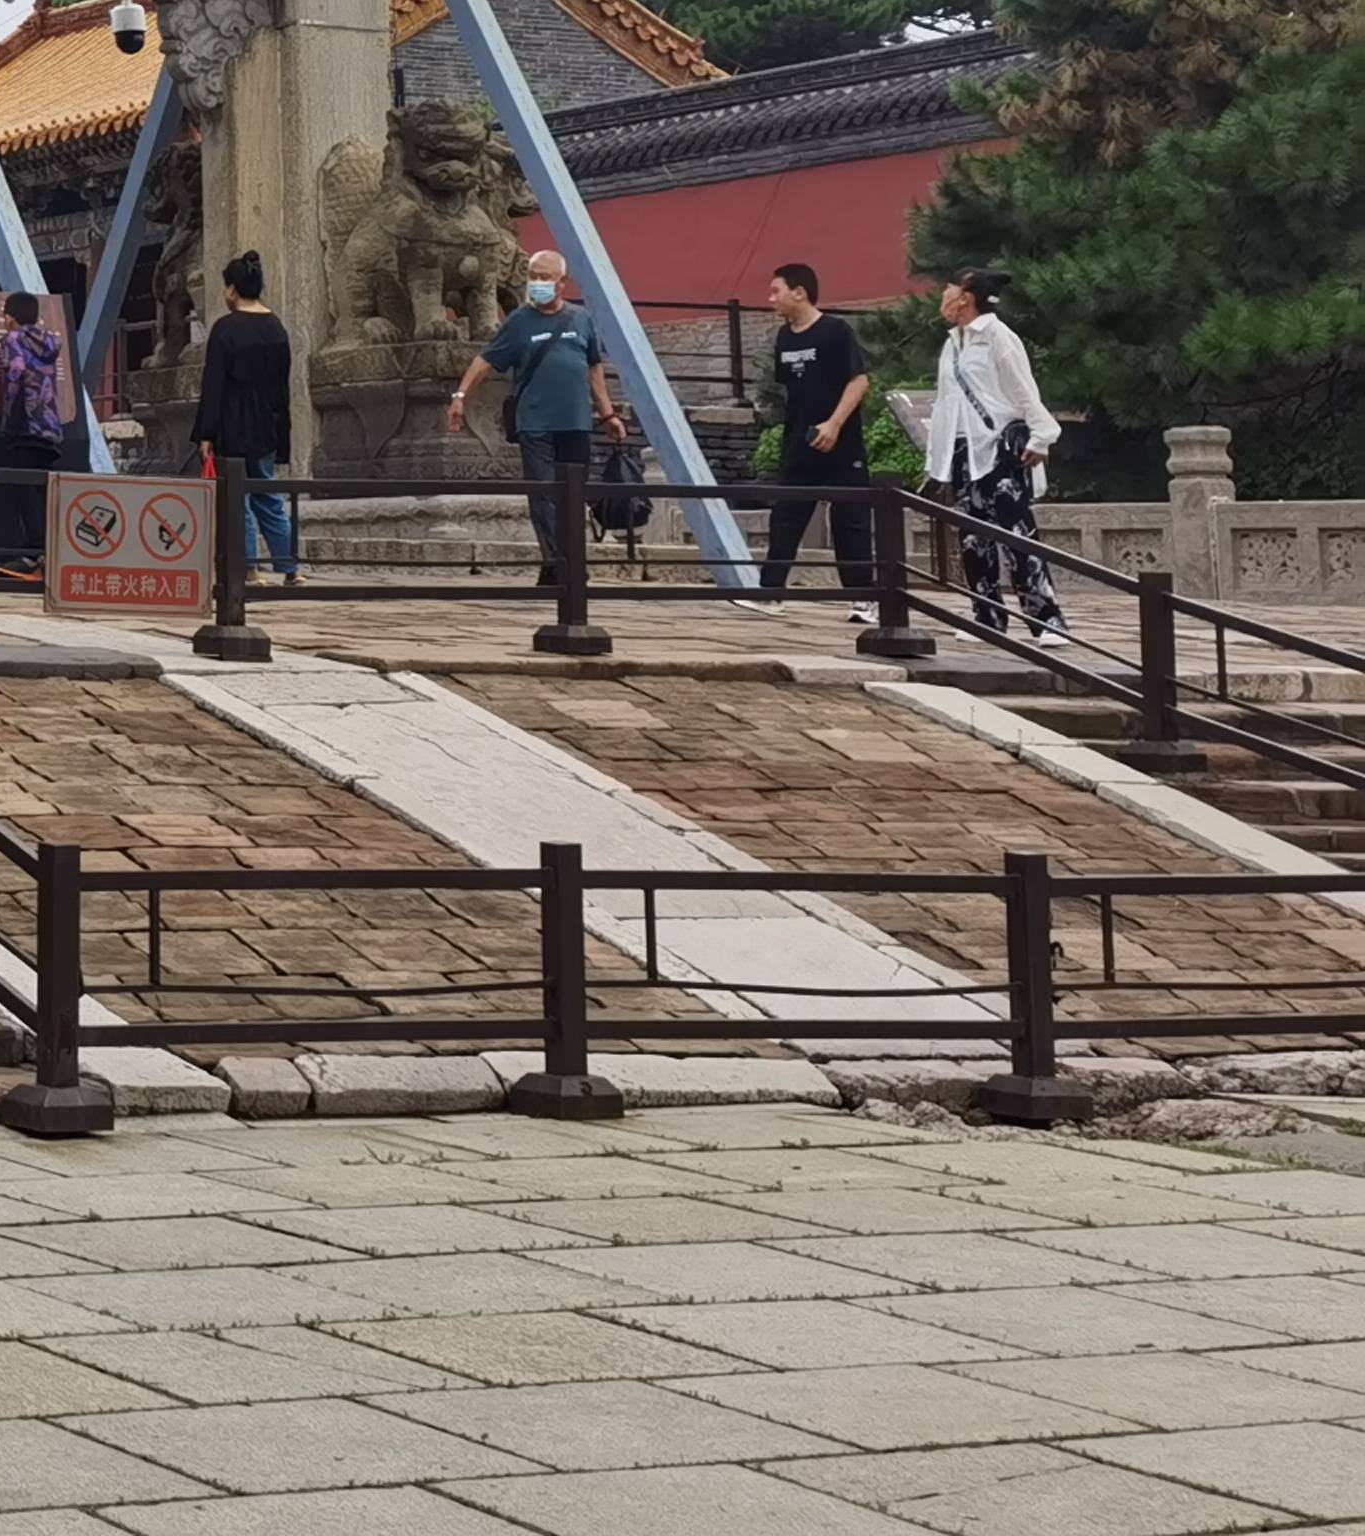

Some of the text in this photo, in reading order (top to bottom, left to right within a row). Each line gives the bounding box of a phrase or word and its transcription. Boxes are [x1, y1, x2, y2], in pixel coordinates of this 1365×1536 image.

[69, 572, 192, 599] 禁止带火种入园
